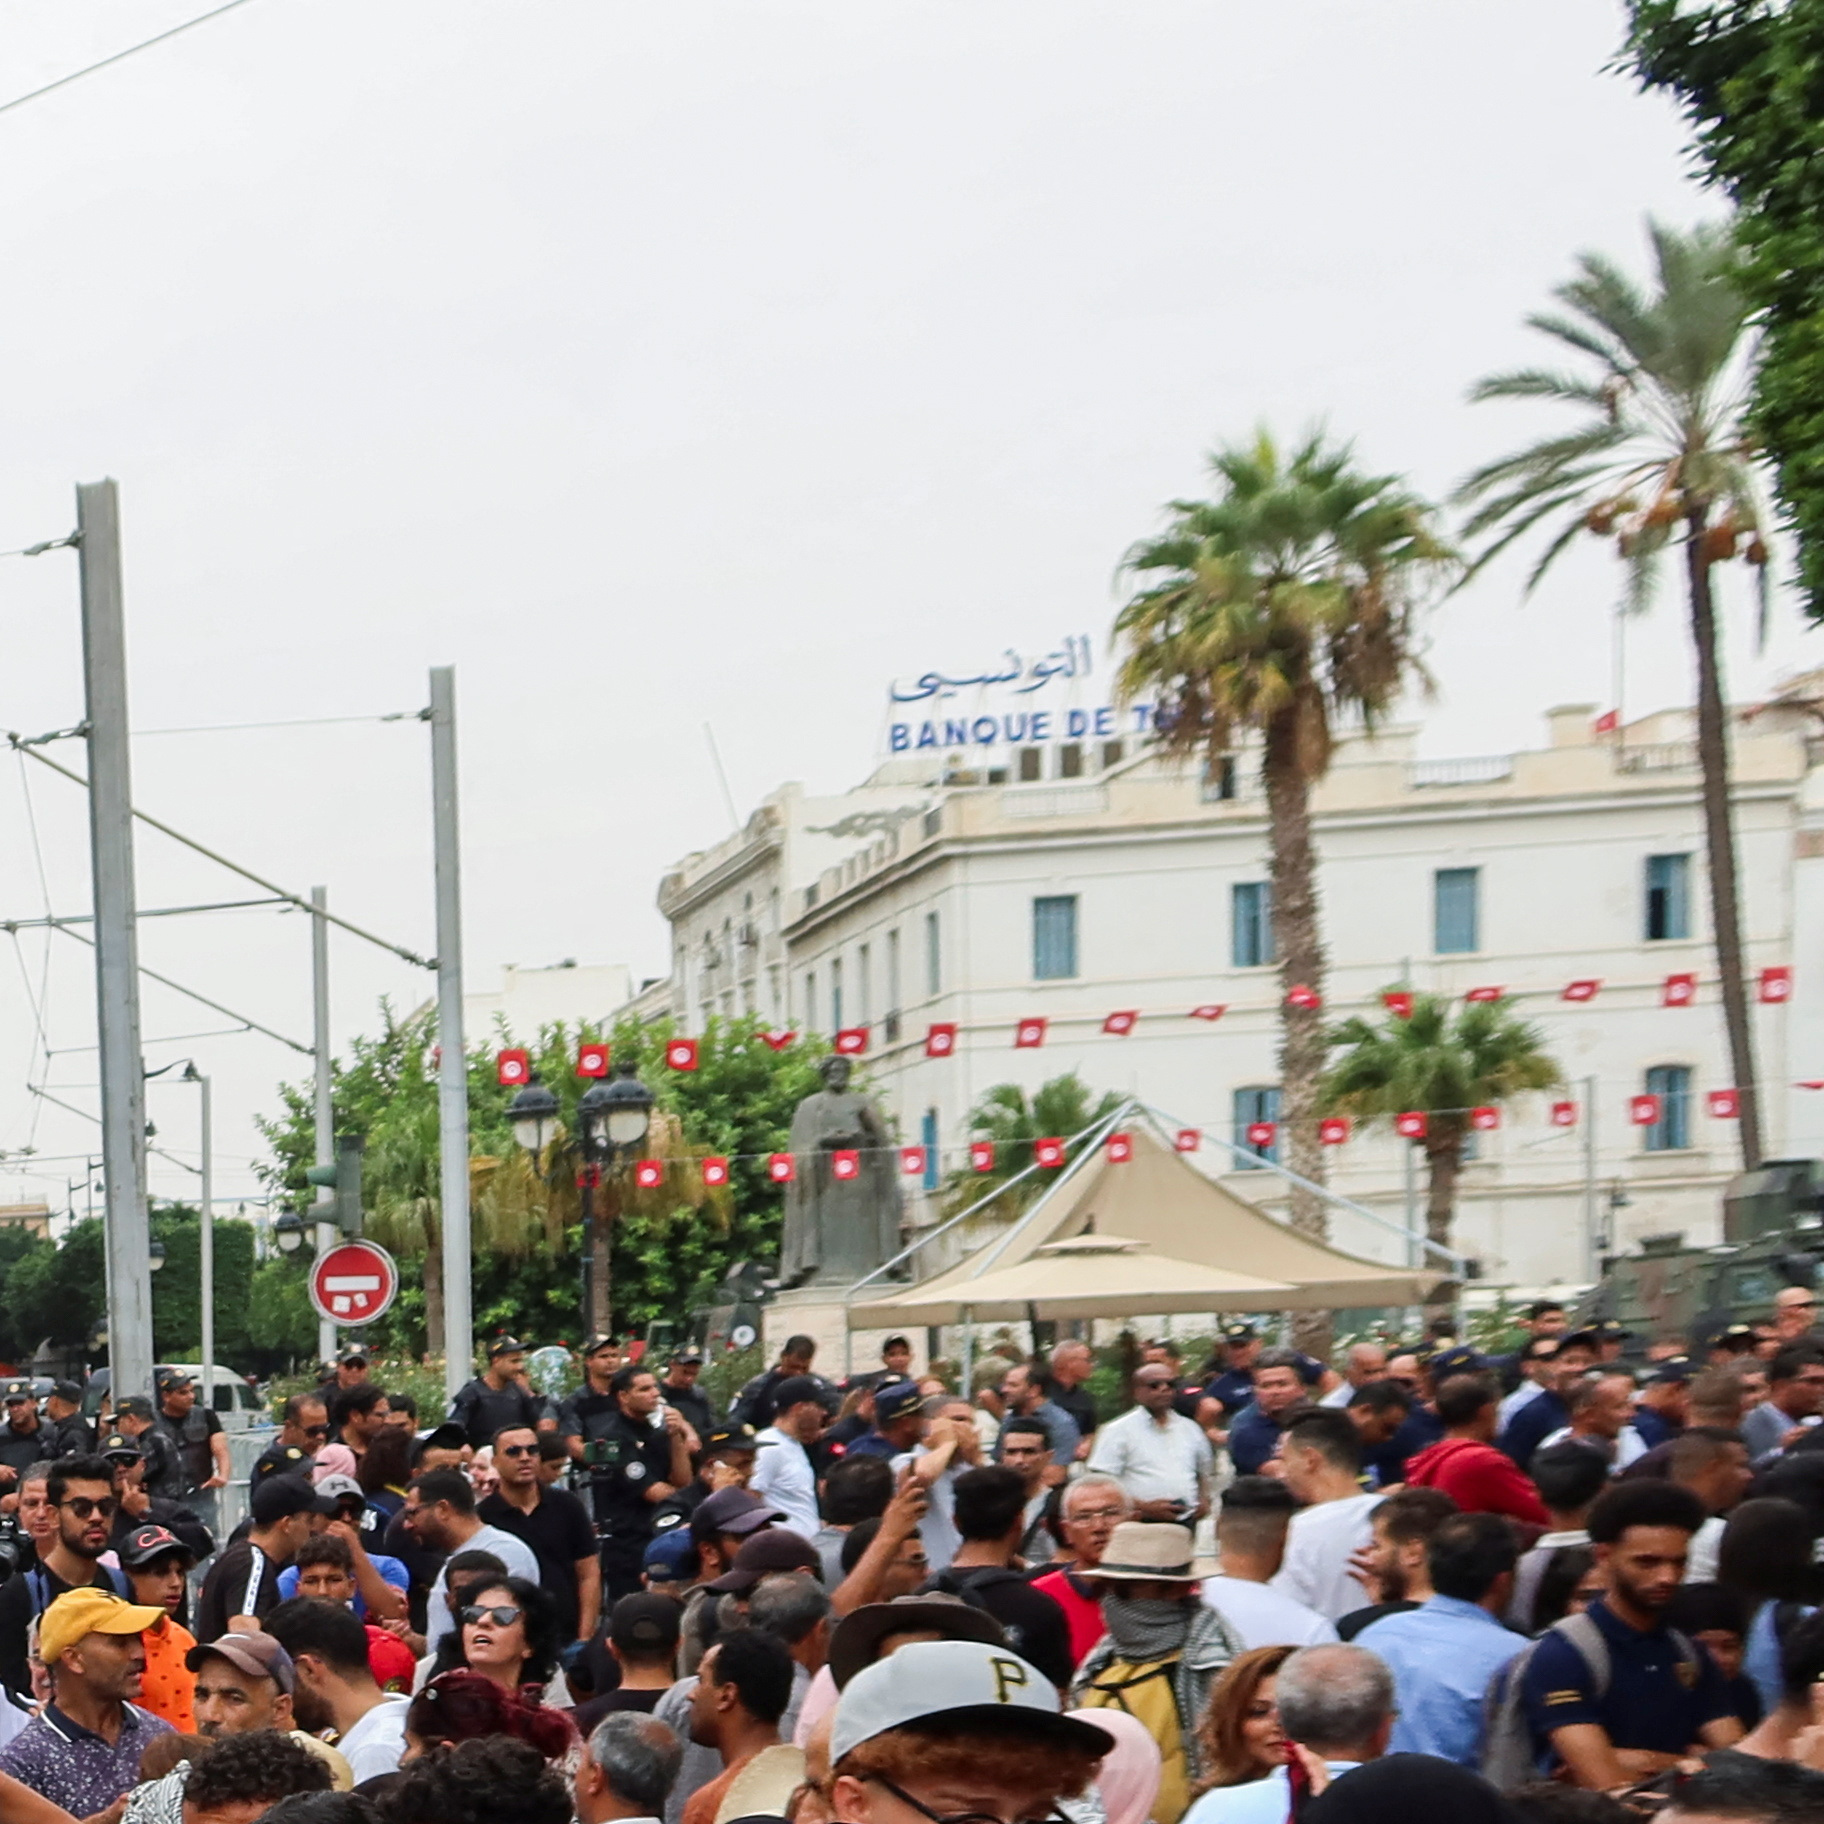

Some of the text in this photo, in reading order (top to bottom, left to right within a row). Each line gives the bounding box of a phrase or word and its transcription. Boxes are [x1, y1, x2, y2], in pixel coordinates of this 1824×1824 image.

[891, 711, 1052, 752] BANQUE
[1068, 706, 1114, 738] DE
[987, 1655, 1029, 1703] P
